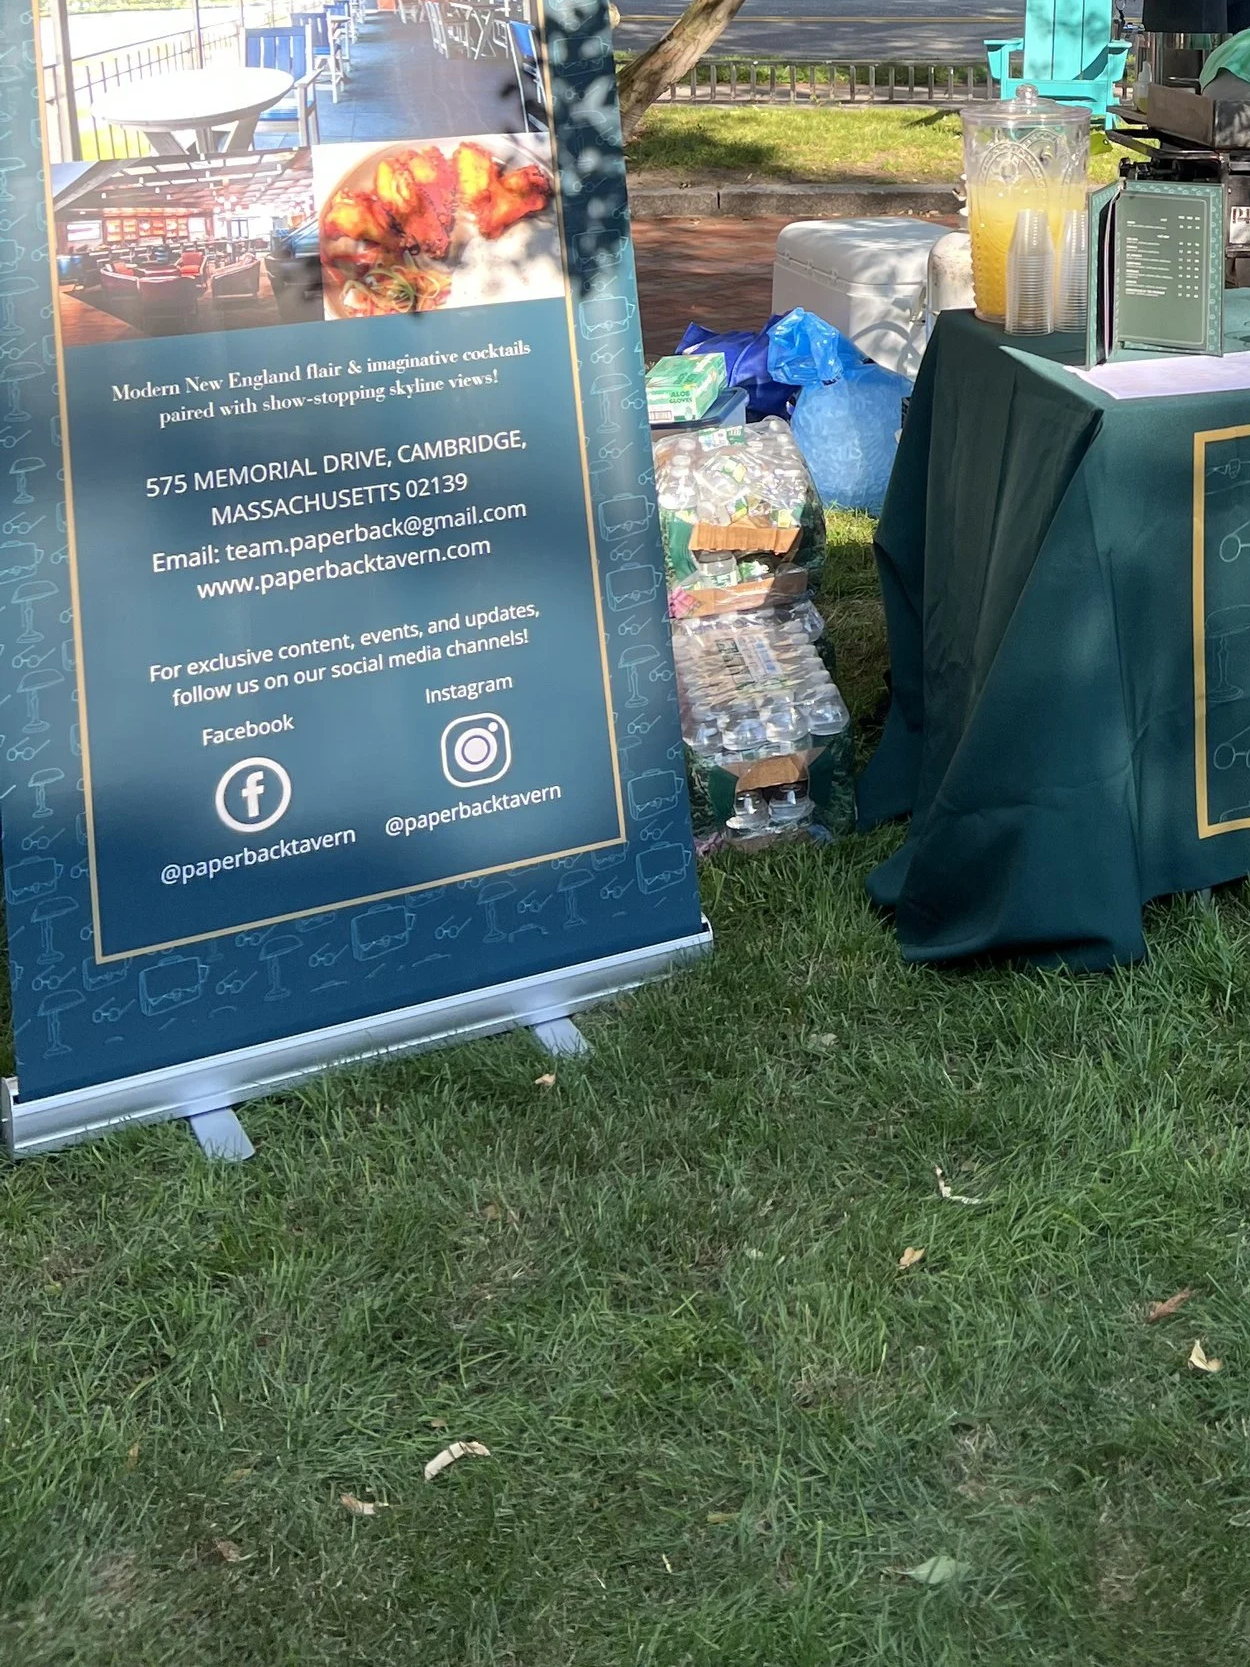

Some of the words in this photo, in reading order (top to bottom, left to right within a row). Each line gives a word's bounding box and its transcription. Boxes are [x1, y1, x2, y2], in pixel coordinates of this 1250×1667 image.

[111, 381, 181, 402] Modern
[184, 376, 224, 394] New
[228, 365, 302, 391] England
[306, 362, 343, 380] flair
[347, 359, 363, 375] &
[366, 350, 459, 374] imaginative
[462, 339, 532, 362] cocktails
[159, 401, 215, 429] paired
[219, 397, 258, 416] with
[262, 384, 386, 412] show-stopping
[389, 377, 445, 399] skyline
[447, 368, 499, 389] views!
[146, 473, 188, 498] 575
[193, 457, 318, 491] MEMORIAL
[323, 447, 392, 474] DRIVE,
[397, 429, 527, 464] CAMBRIDGE,
[211, 482, 401, 526] MASSACHUSETTS
[405, 472, 468, 498] 02139
[152, 544, 221, 573] Email:
[224, 503, 527, 562] team.paperback@gmail.com
[196, 540, 491, 599] www.paperbacktavern.com
[149, 664, 183, 683] For
[186, 648, 274, 676] exclusive
[277, 633, 356, 660] content,
[360, 623, 424, 646] events,
[427, 612, 461, 635] and
[464, 603, 540, 630] updates,
[171, 683, 232, 707] follow
[236, 679, 260, 695] us
[263, 673, 289, 690] on
[293, 666, 327, 685] our
[330, 653, 384, 679] social
[388, 644, 442, 669] media
[445, 628, 529, 658] channels!
[425, 676, 513, 704] Instagram
[202, 713, 295, 747] Facebook
[385, 785, 562, 837] @paperbacktavern
[160, 829, 356, 885] @paperbacktavern
